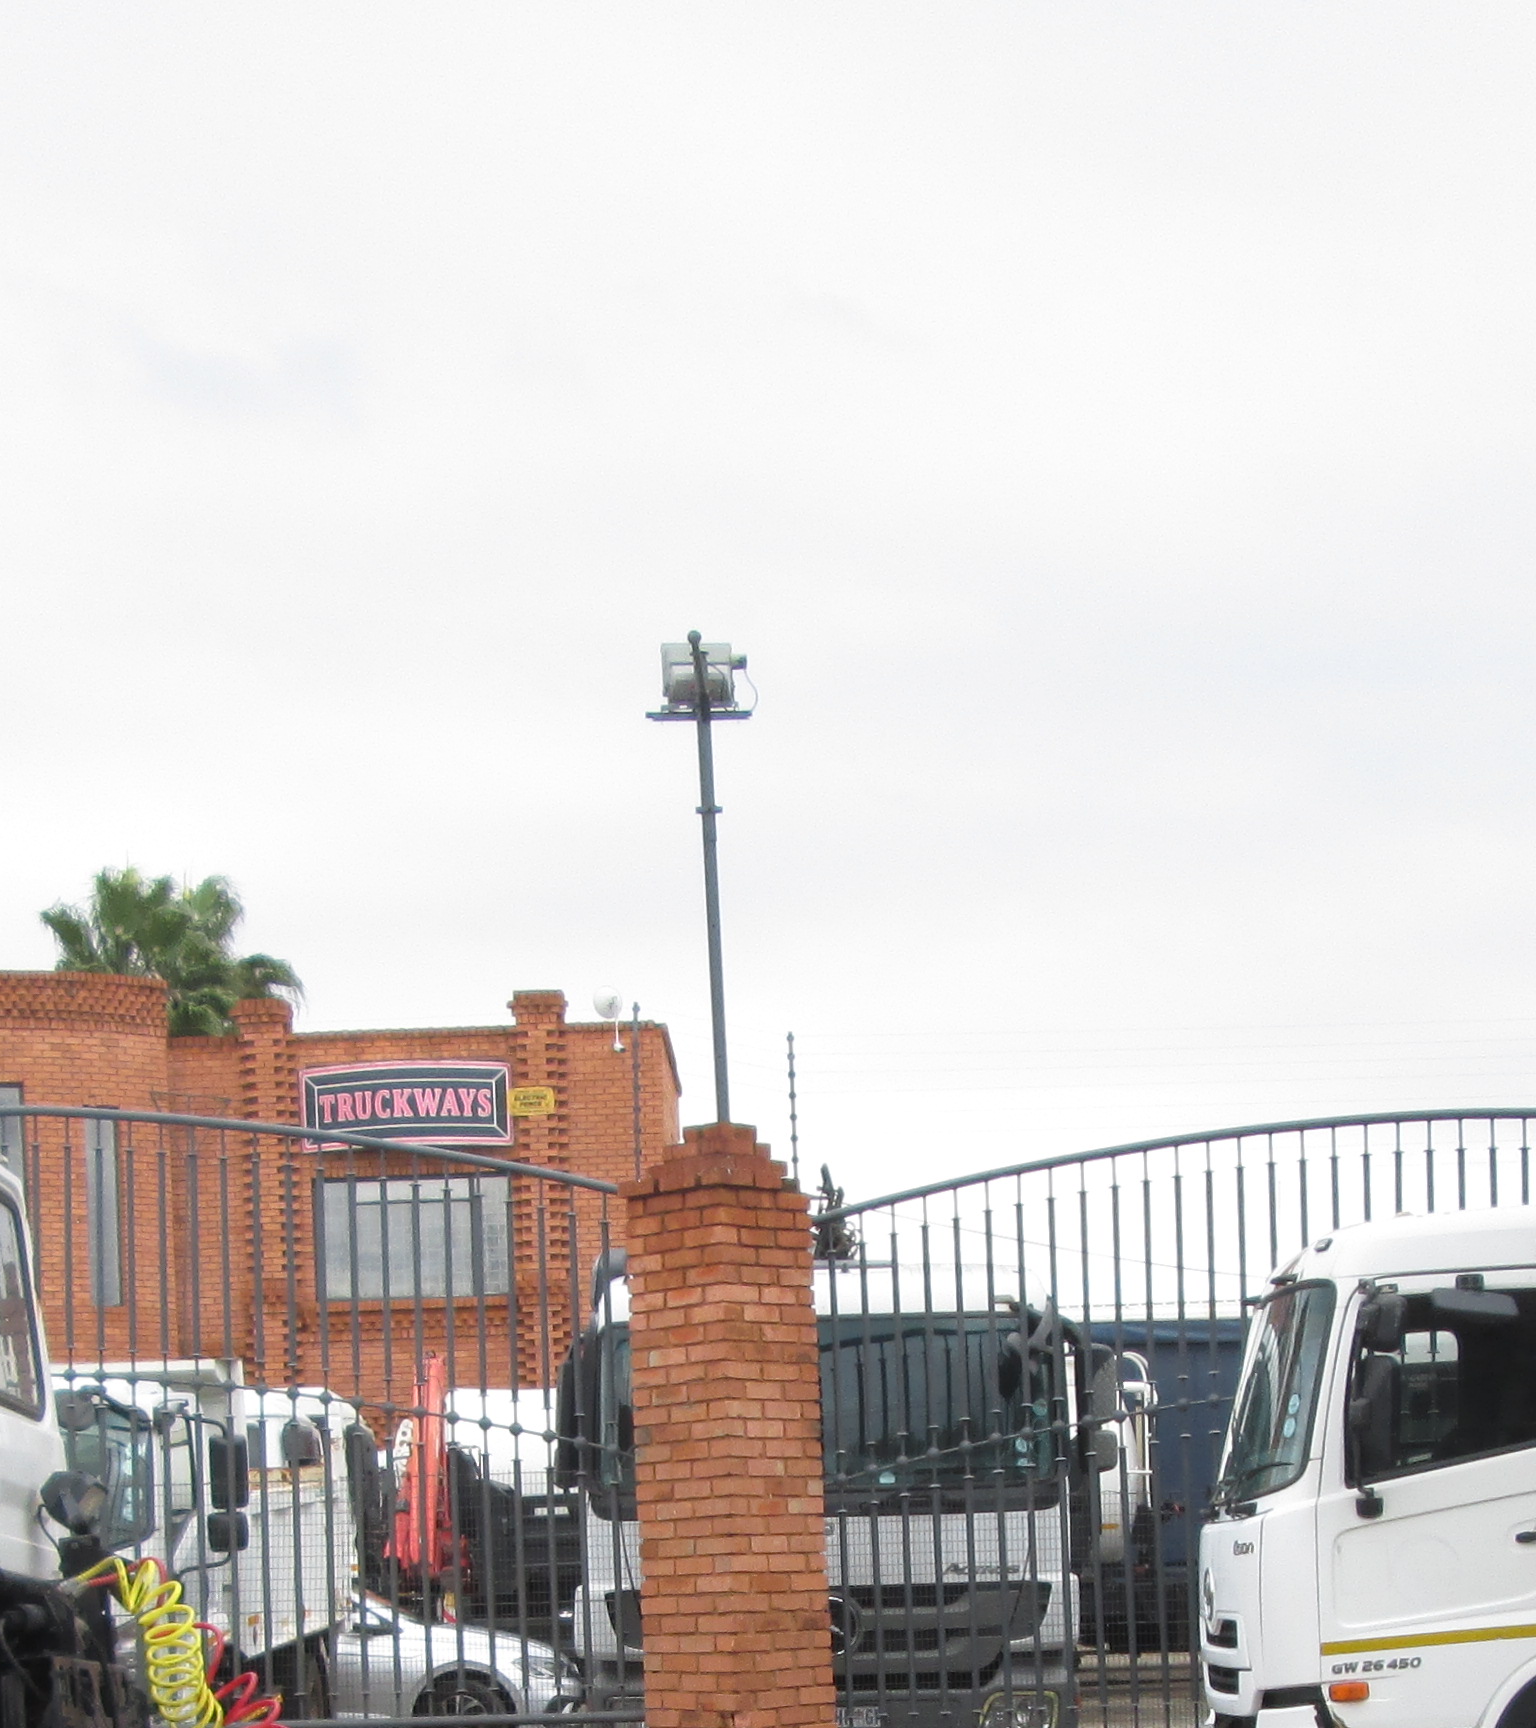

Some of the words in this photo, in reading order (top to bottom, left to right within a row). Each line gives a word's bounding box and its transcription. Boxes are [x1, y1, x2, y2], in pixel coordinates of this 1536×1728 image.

[319, 1087, 493, 1123] TRUCKWAYS
[1331, 1661, 1359, 1675] GW
[1362, 1659, 1385, 1672] 26
[1386, 1656, 1422, 1670] 450
